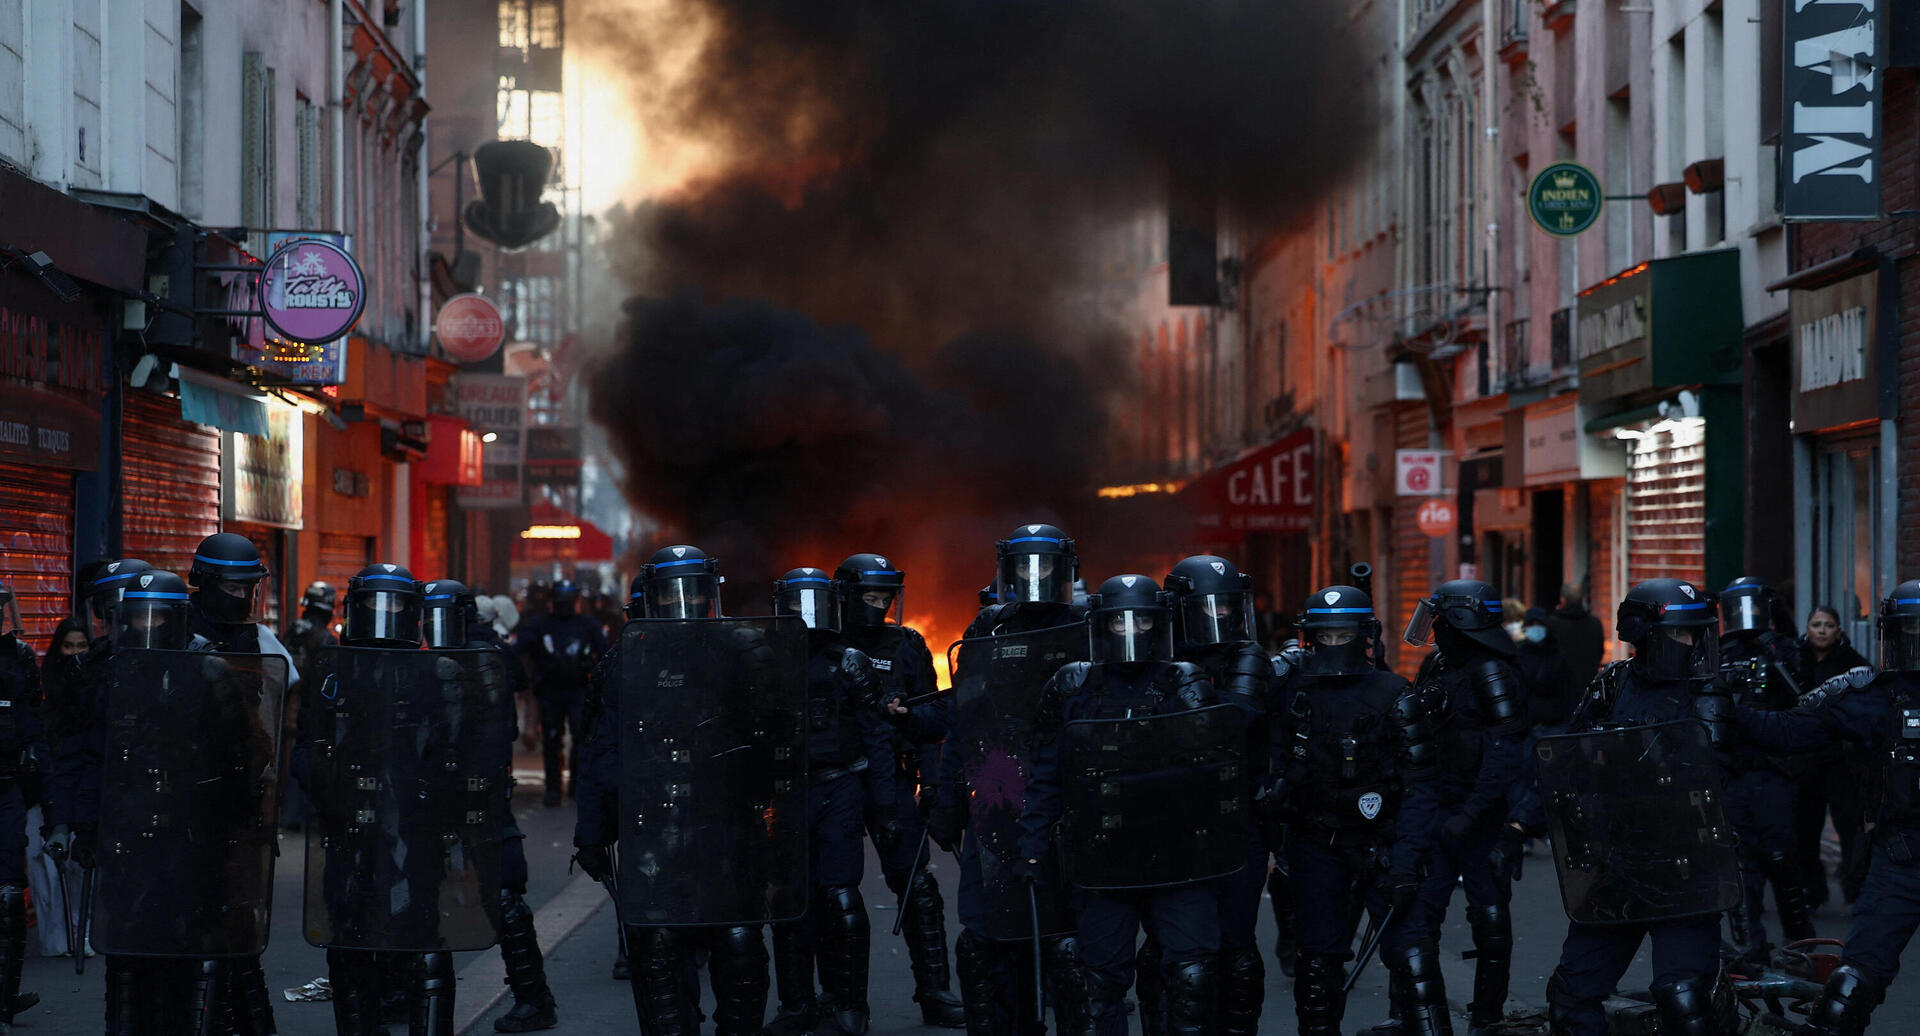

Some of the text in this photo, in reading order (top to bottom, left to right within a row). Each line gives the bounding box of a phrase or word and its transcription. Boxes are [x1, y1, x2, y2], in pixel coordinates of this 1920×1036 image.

[1542, 188, 1590, 201] INDIEN
[38, 427, 71, 455] TURQUES
[1228, 443, 1313, 505] CAFE
[1420, 502, 1451, 524] ria
